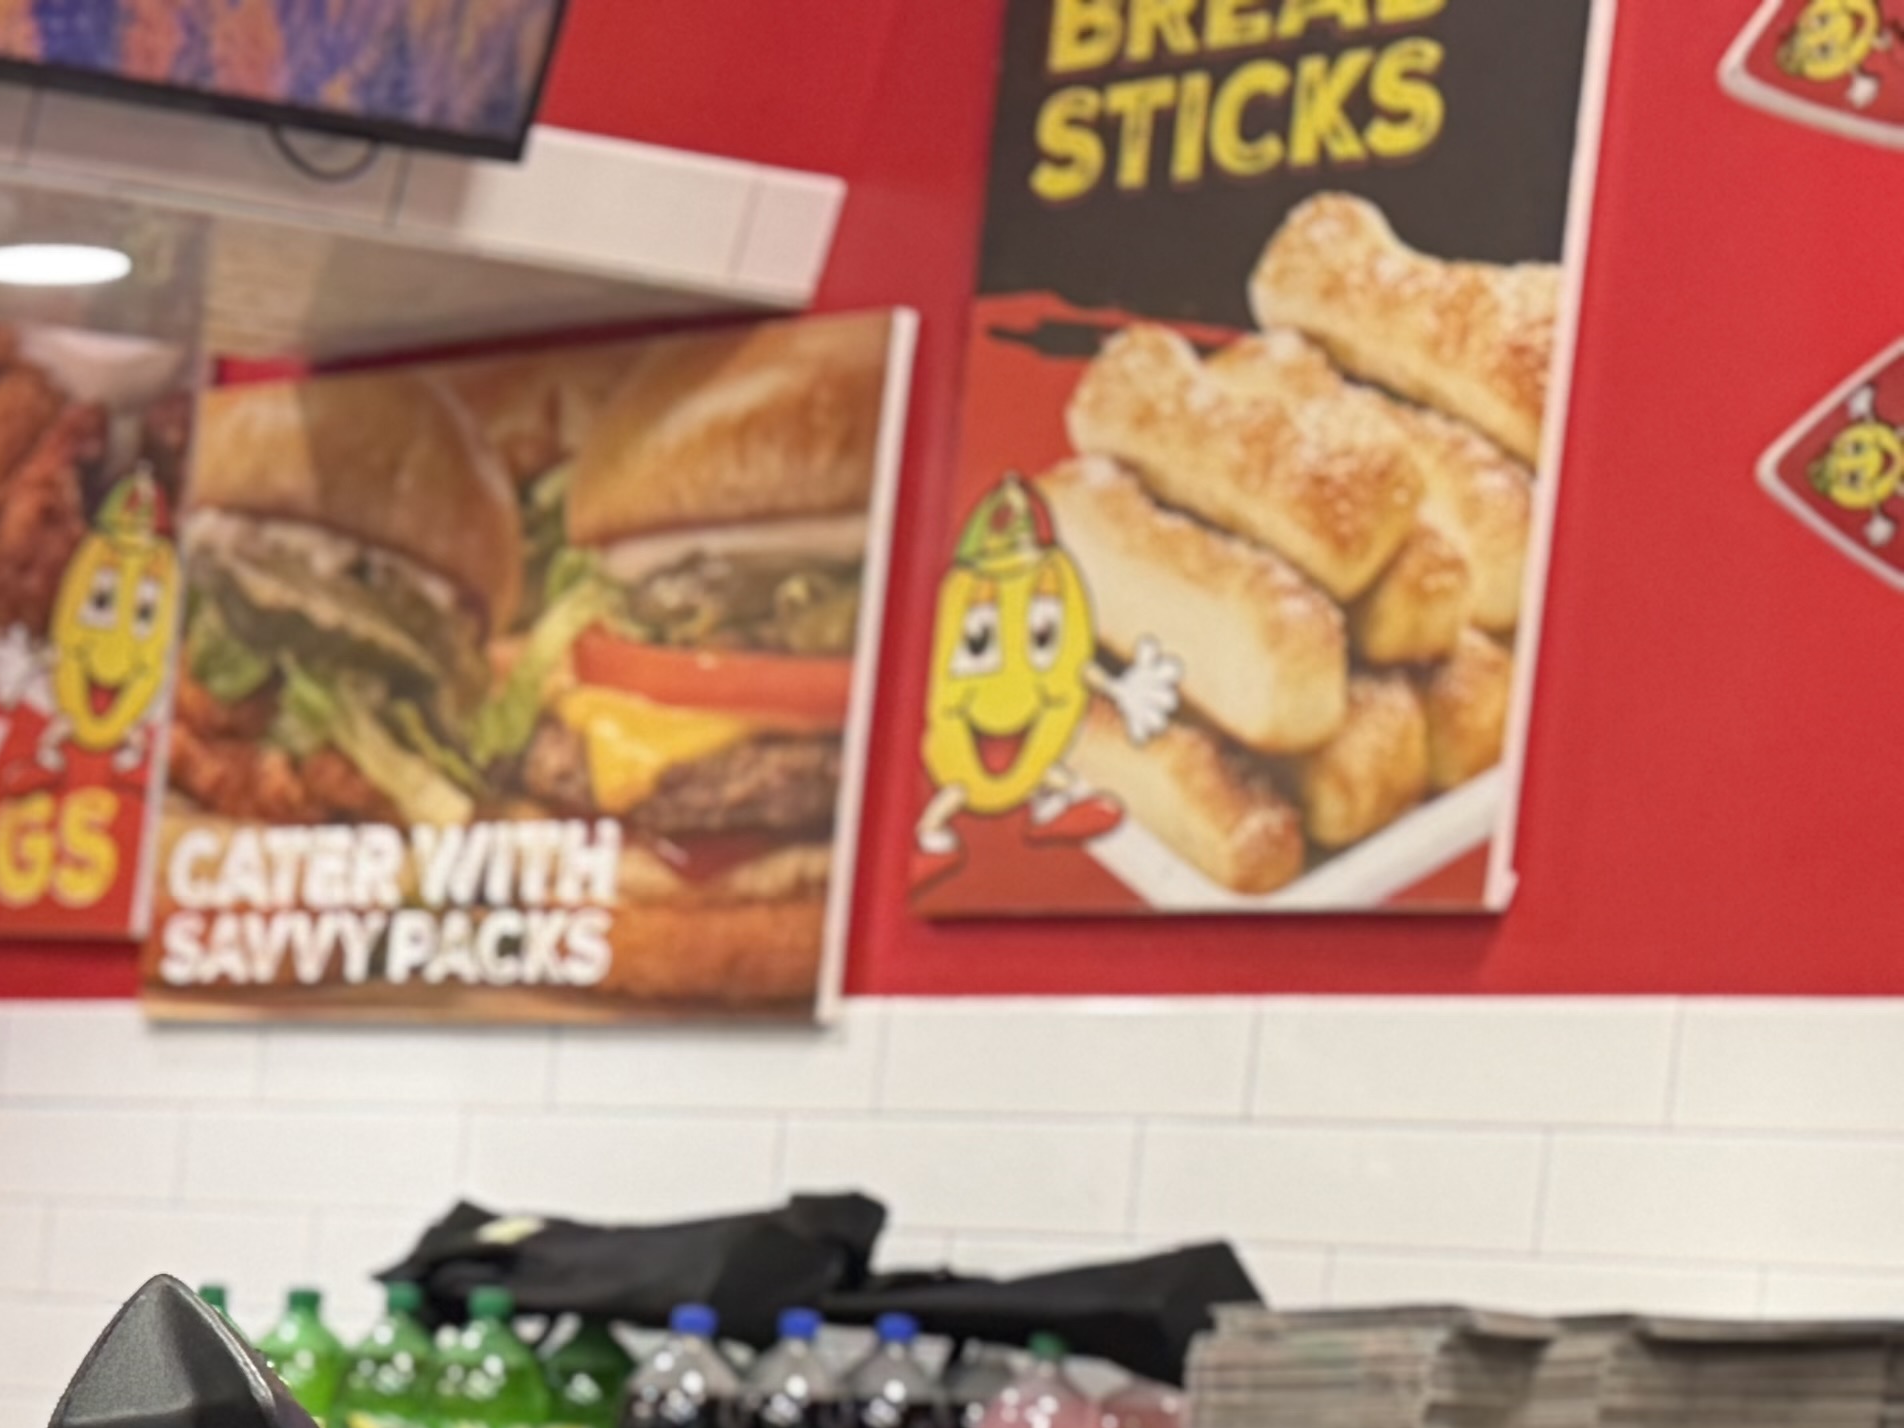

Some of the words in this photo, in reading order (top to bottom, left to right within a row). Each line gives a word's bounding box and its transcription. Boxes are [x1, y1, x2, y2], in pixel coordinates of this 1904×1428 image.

[1047, 0, 1448, 73] BRE
[1030, 36, 1446, 200] STICKS
[166, 817, 406, 909] CATER
[410, 815, 622, 906] WITH
[159, 906, 389, 986] SAVVY
[390, 901, 614, 984] PACKS
